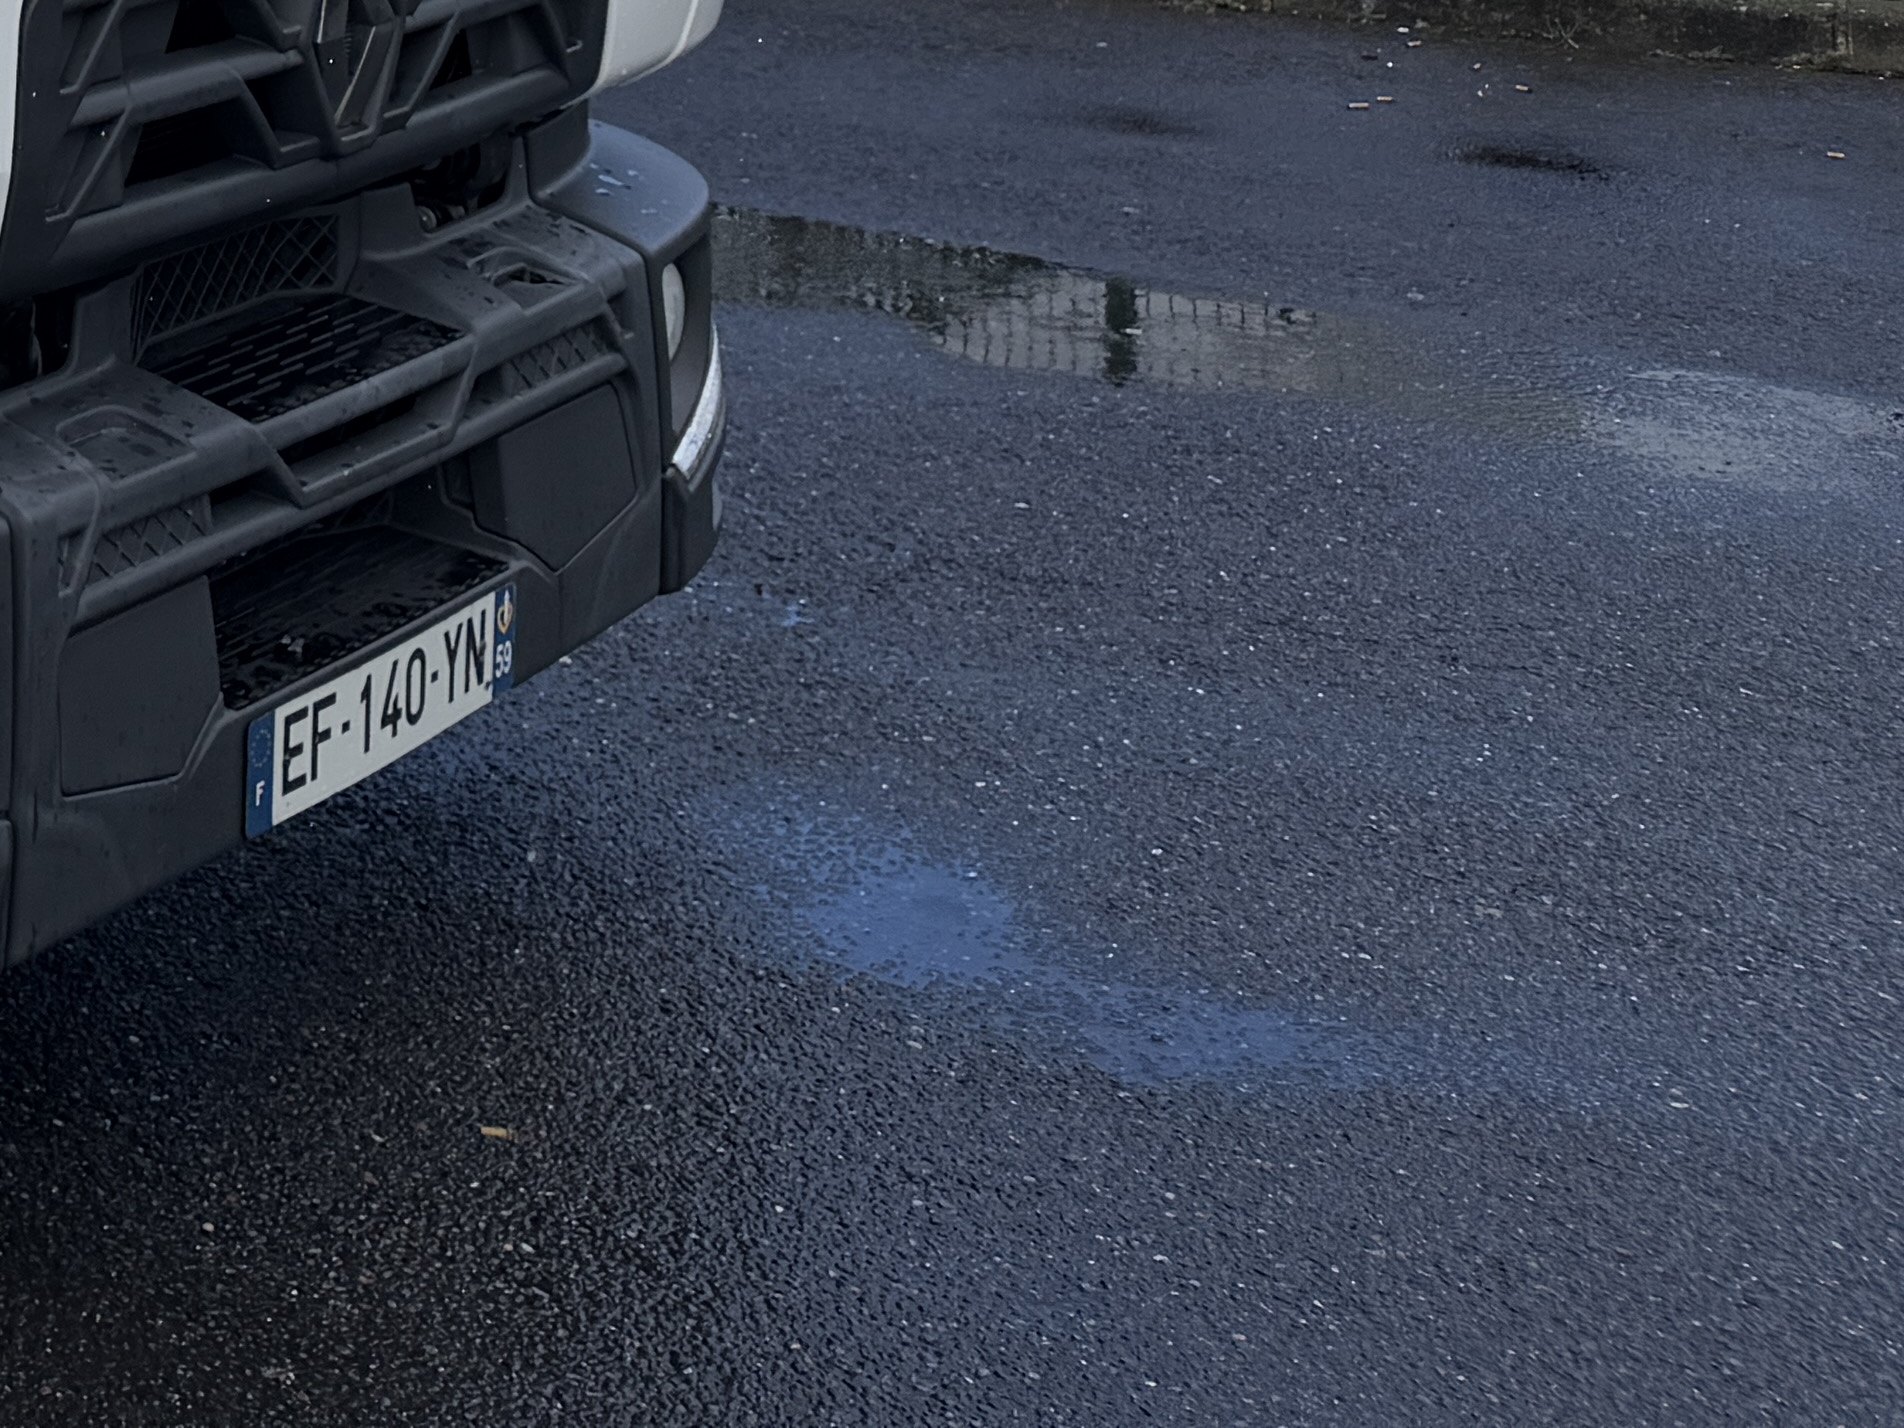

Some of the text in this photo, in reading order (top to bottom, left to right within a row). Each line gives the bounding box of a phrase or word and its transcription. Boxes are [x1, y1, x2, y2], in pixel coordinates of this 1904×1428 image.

[255, 609, 512, 807] F EF-140-YN 59
